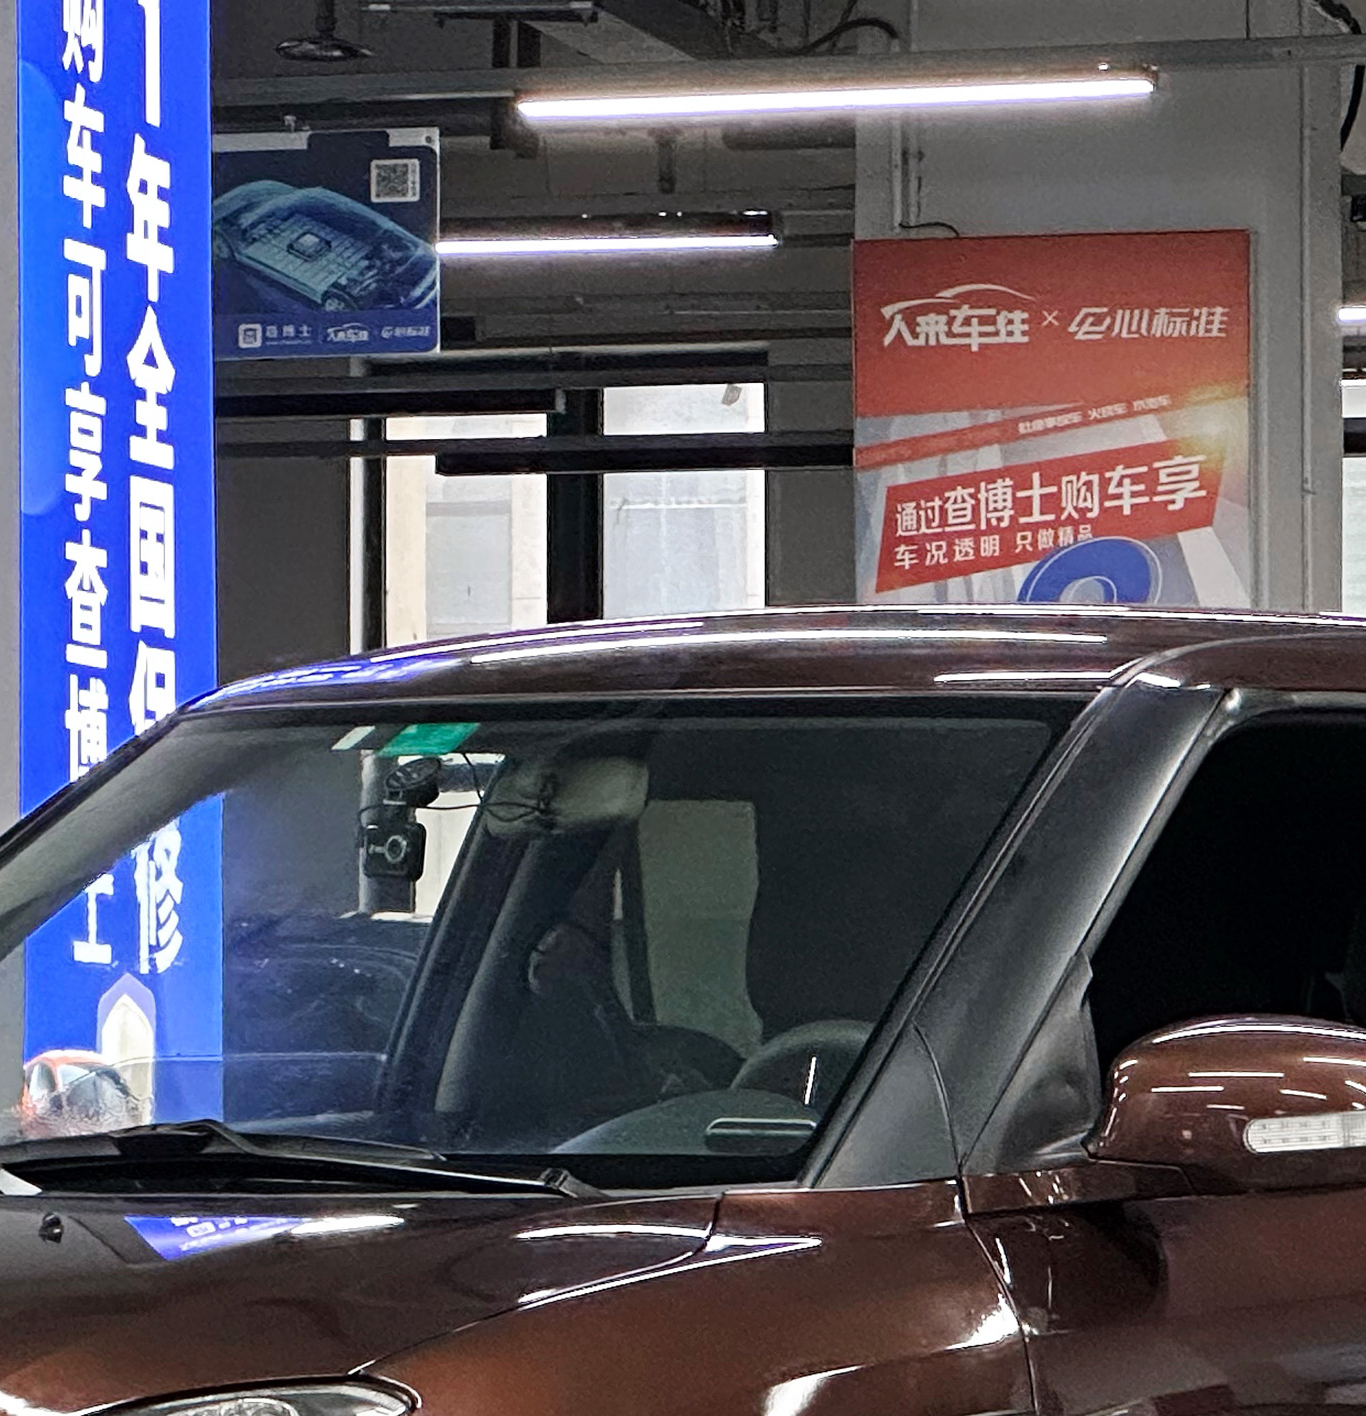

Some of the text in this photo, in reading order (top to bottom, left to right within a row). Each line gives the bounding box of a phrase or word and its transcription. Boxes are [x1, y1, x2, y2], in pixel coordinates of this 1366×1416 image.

[894, 454, 1208, 537] 通过查博士购车享
[893, 534, 1001, 570] 车况透明
